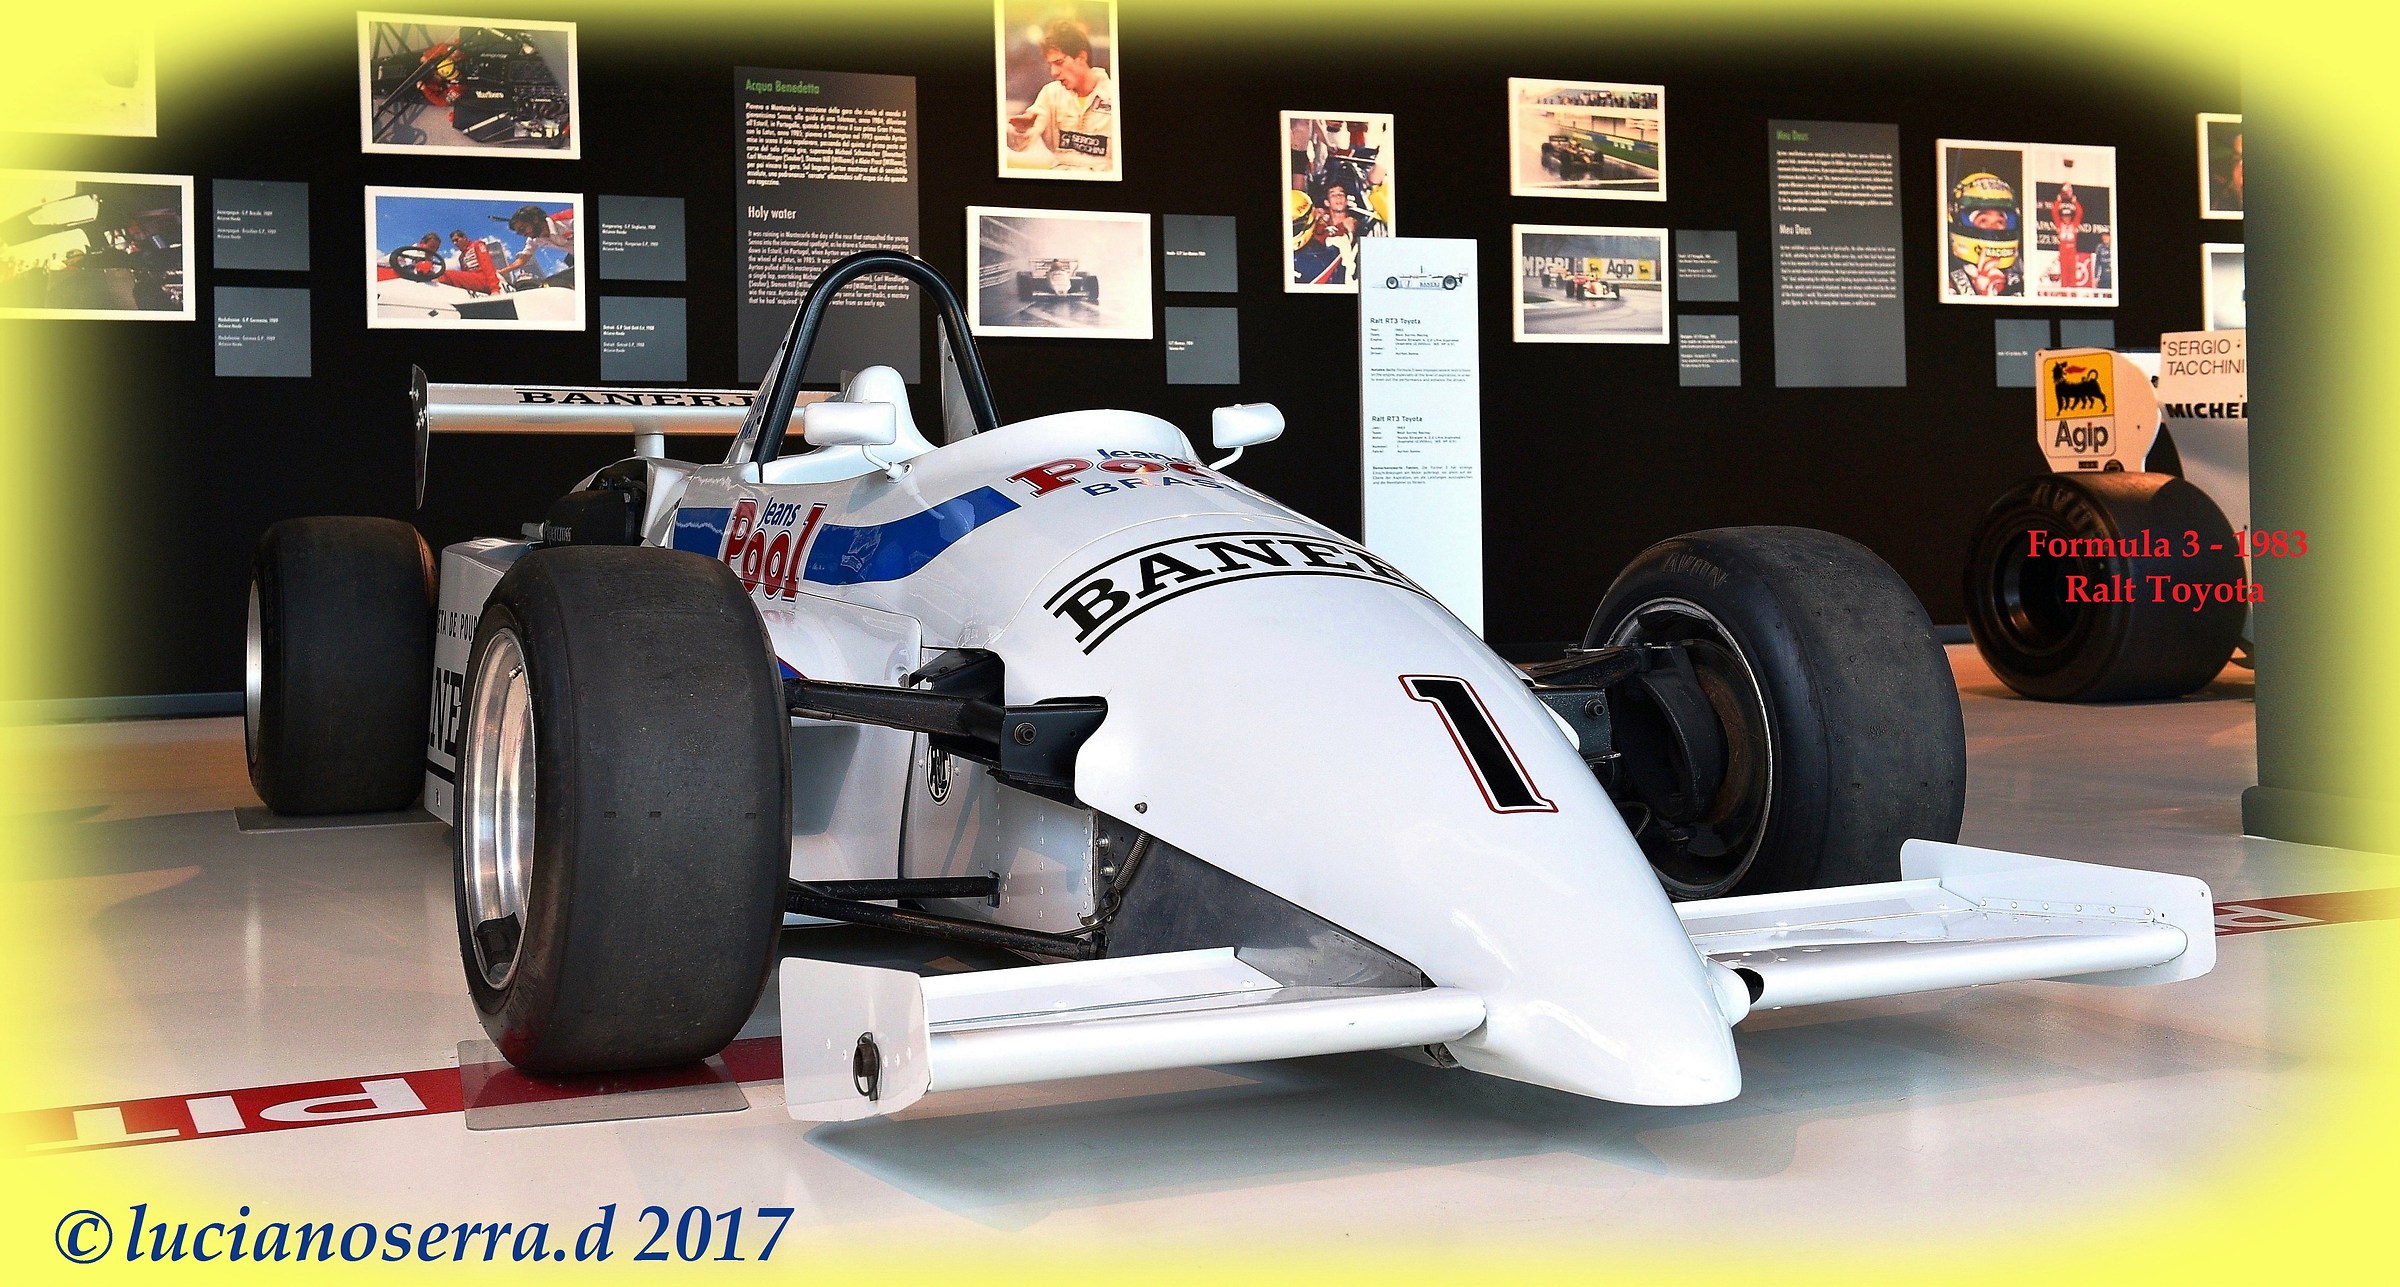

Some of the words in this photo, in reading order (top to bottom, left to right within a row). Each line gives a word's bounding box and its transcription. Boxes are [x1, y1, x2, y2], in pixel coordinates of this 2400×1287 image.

[746, 78, 772, 94] Acqua
[748, 205, 769, 222] Holy
[771, 208, 797, 220] water
[1606, 260, 1634, 278] Agip
[2168, 338, 2230, 356] SERGIO
[2168, 360, 2245, 376] TACCHINI
[516, 392, 754, 406] BANERJ
[2055, 420, 2108, 454] Agip
[1005, 456, 1212, 498] Poo
[757, 497, 802, 528] Jeans
[721, 498, 828, 602] Pool
[437, 609, 447, 636] ETA
[1399, 675, 1558, 814] 1
[24, 1077, 428, 1152] PIT
